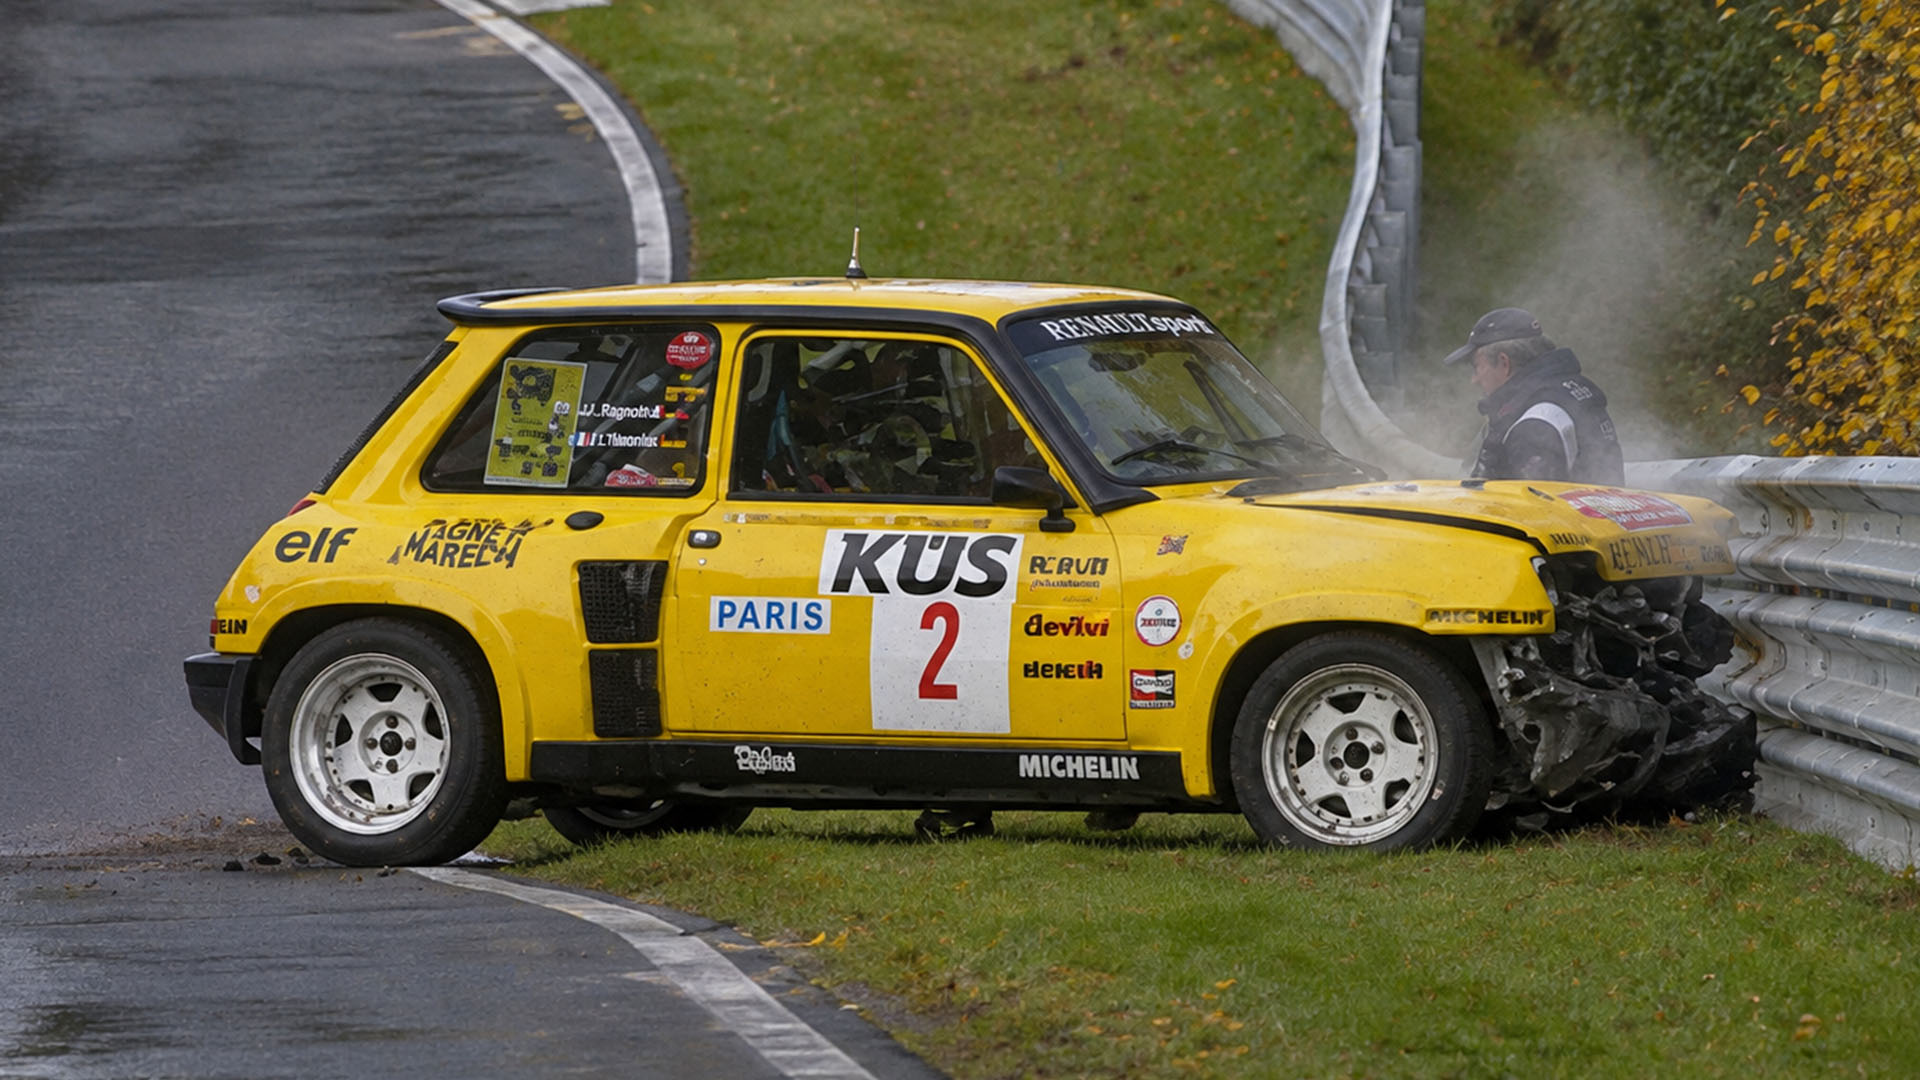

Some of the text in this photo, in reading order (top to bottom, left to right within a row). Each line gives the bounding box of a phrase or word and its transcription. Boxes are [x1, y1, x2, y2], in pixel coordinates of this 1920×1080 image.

[274, 527, 358, 564] elf
[717, 600, 823, 631] PARIS
[918, 601, 960, 700] 2
[1019, 755, 1140, 781] MICHELIN
